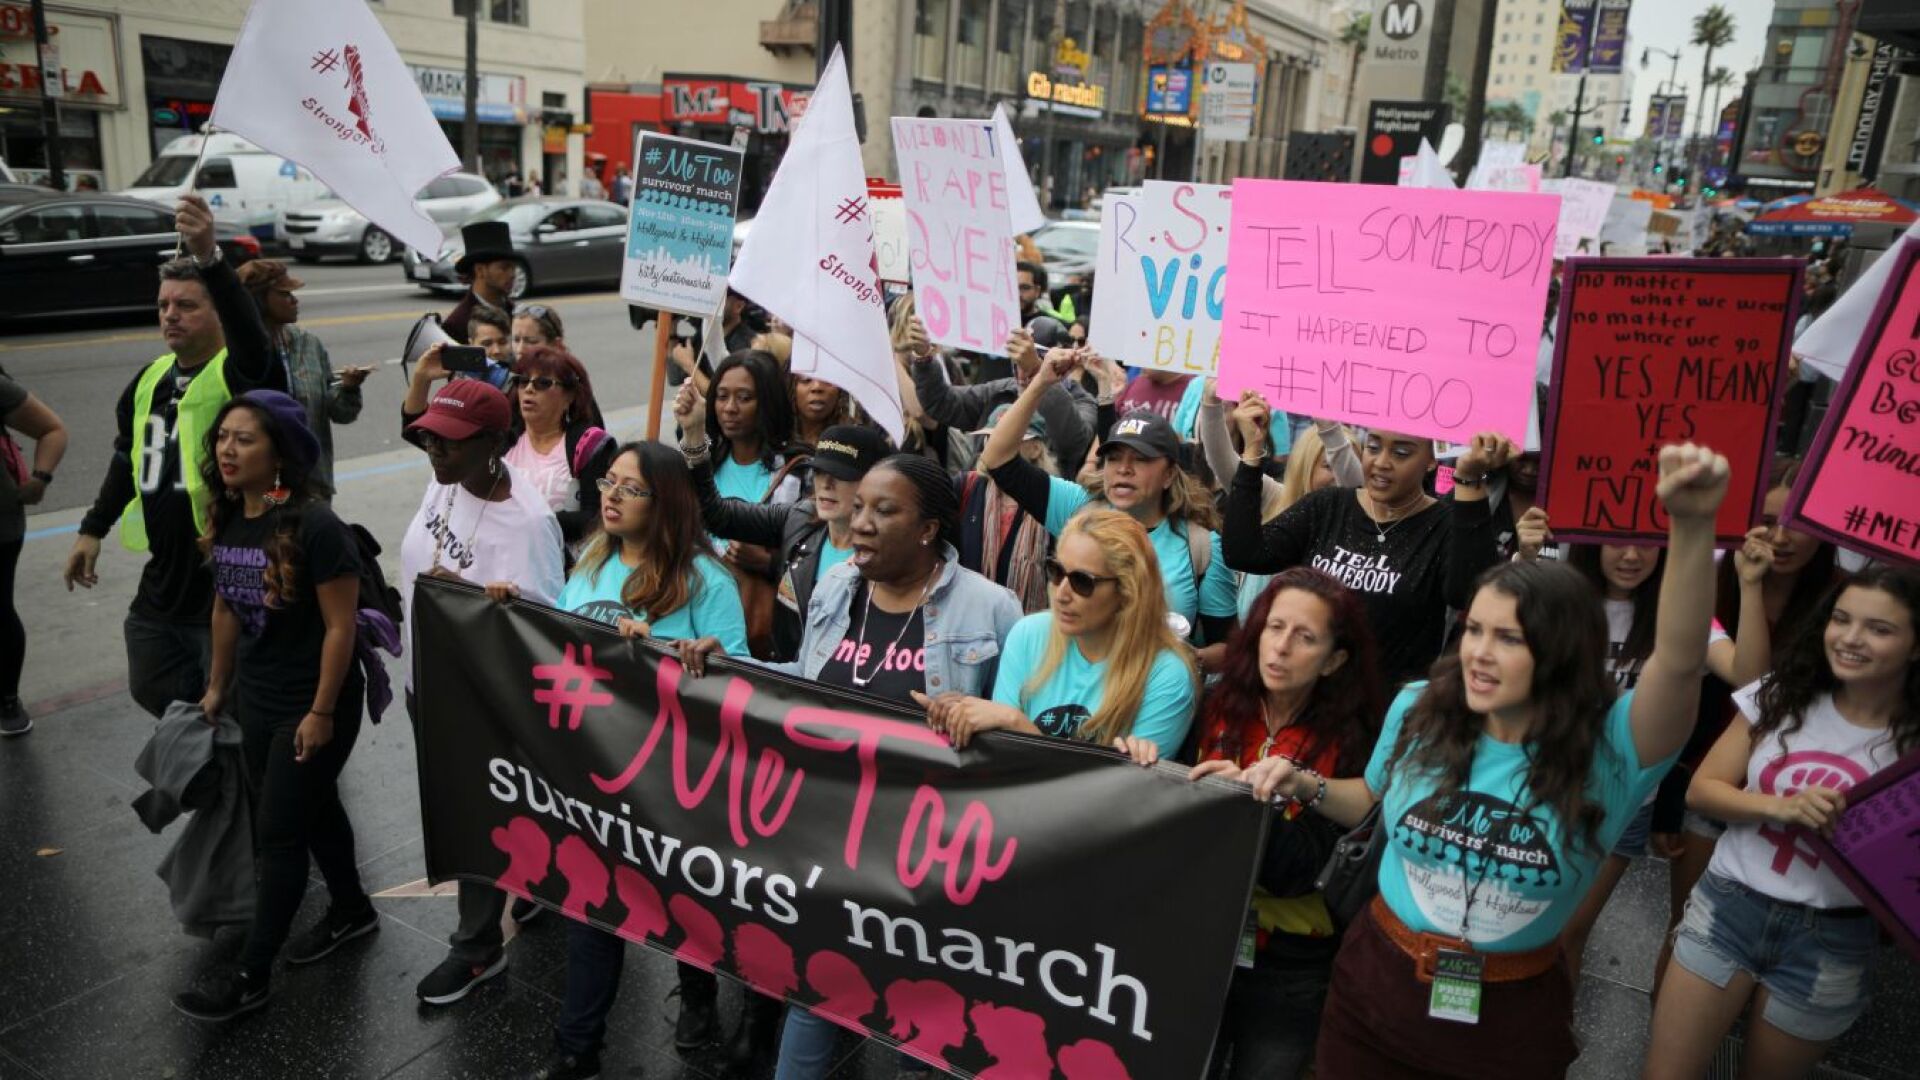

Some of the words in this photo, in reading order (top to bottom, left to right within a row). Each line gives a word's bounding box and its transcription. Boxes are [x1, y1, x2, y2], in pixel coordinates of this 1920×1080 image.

[1374, 46, 1419, 60] Metro
[1374, 120, 1421, 133] Highland
[696, 186, 733, 201] march
[914, 160, 1008, 211] RAPE
[1246, 224, 1375, 294] TELL
[1359, 206, 1557, 287] SOMEBODY
[1576, 274, 1603, 288] no
[1612, 272, 1695, 289] matter
[1630, 294, 1686, 307] what
[1697, 297, 1727, 309] we
[921, 284, 1010, 352] OLD
[1573, 311, 1598, 325] no
[1606, 311, 1696, 329] matter
[1239, 311, 1281, 337] IT
[1297, 315, 1427, 354] HAPPENED
[1457, 317, 1518, 358] TO
[1615, 329, 1674, 347] where
[1687, 332, 1719, 348] we
[1735, 338, 1759, 353] go
[1262, 355, 1474, 429] #METOO
[1594, 354, 1654, 400] YES
[1674, 355, 1773, 406] MEANS
[1116, 419, 1152, 435] CAT
[1635, 402, 1698, 440] YES
[1576, 455, 1613, 472] NO
[1333, 544, 1391, 572] TELL
[1311, 554, 1402, 594] SOMEBODY
[487, 757, 824, 925] survivors'
[843, 899, 1154, 1042] march
